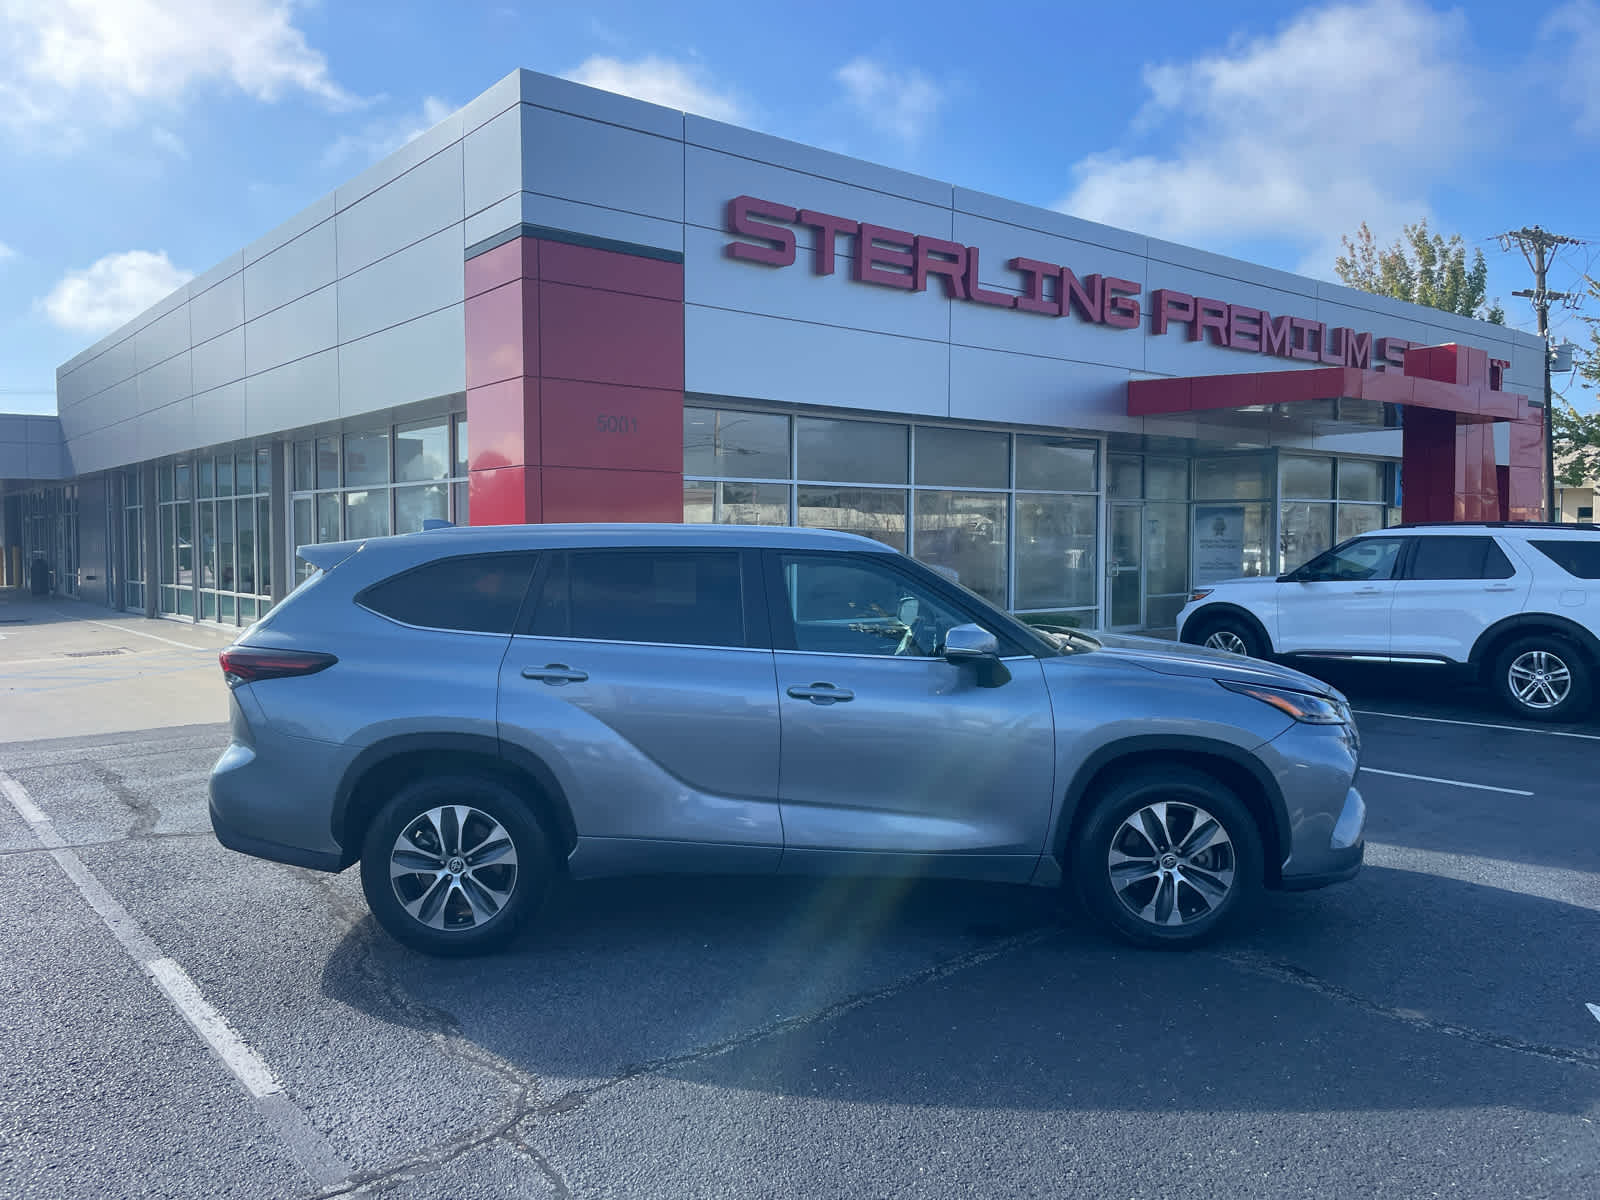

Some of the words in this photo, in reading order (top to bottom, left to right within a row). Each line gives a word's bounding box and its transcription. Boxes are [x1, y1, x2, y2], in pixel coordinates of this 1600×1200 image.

[727, 195, 1141, 330] STERLING
[1151, 288, 1373, 370] PREMIUM
[596, 413, 638, 433] 5001
